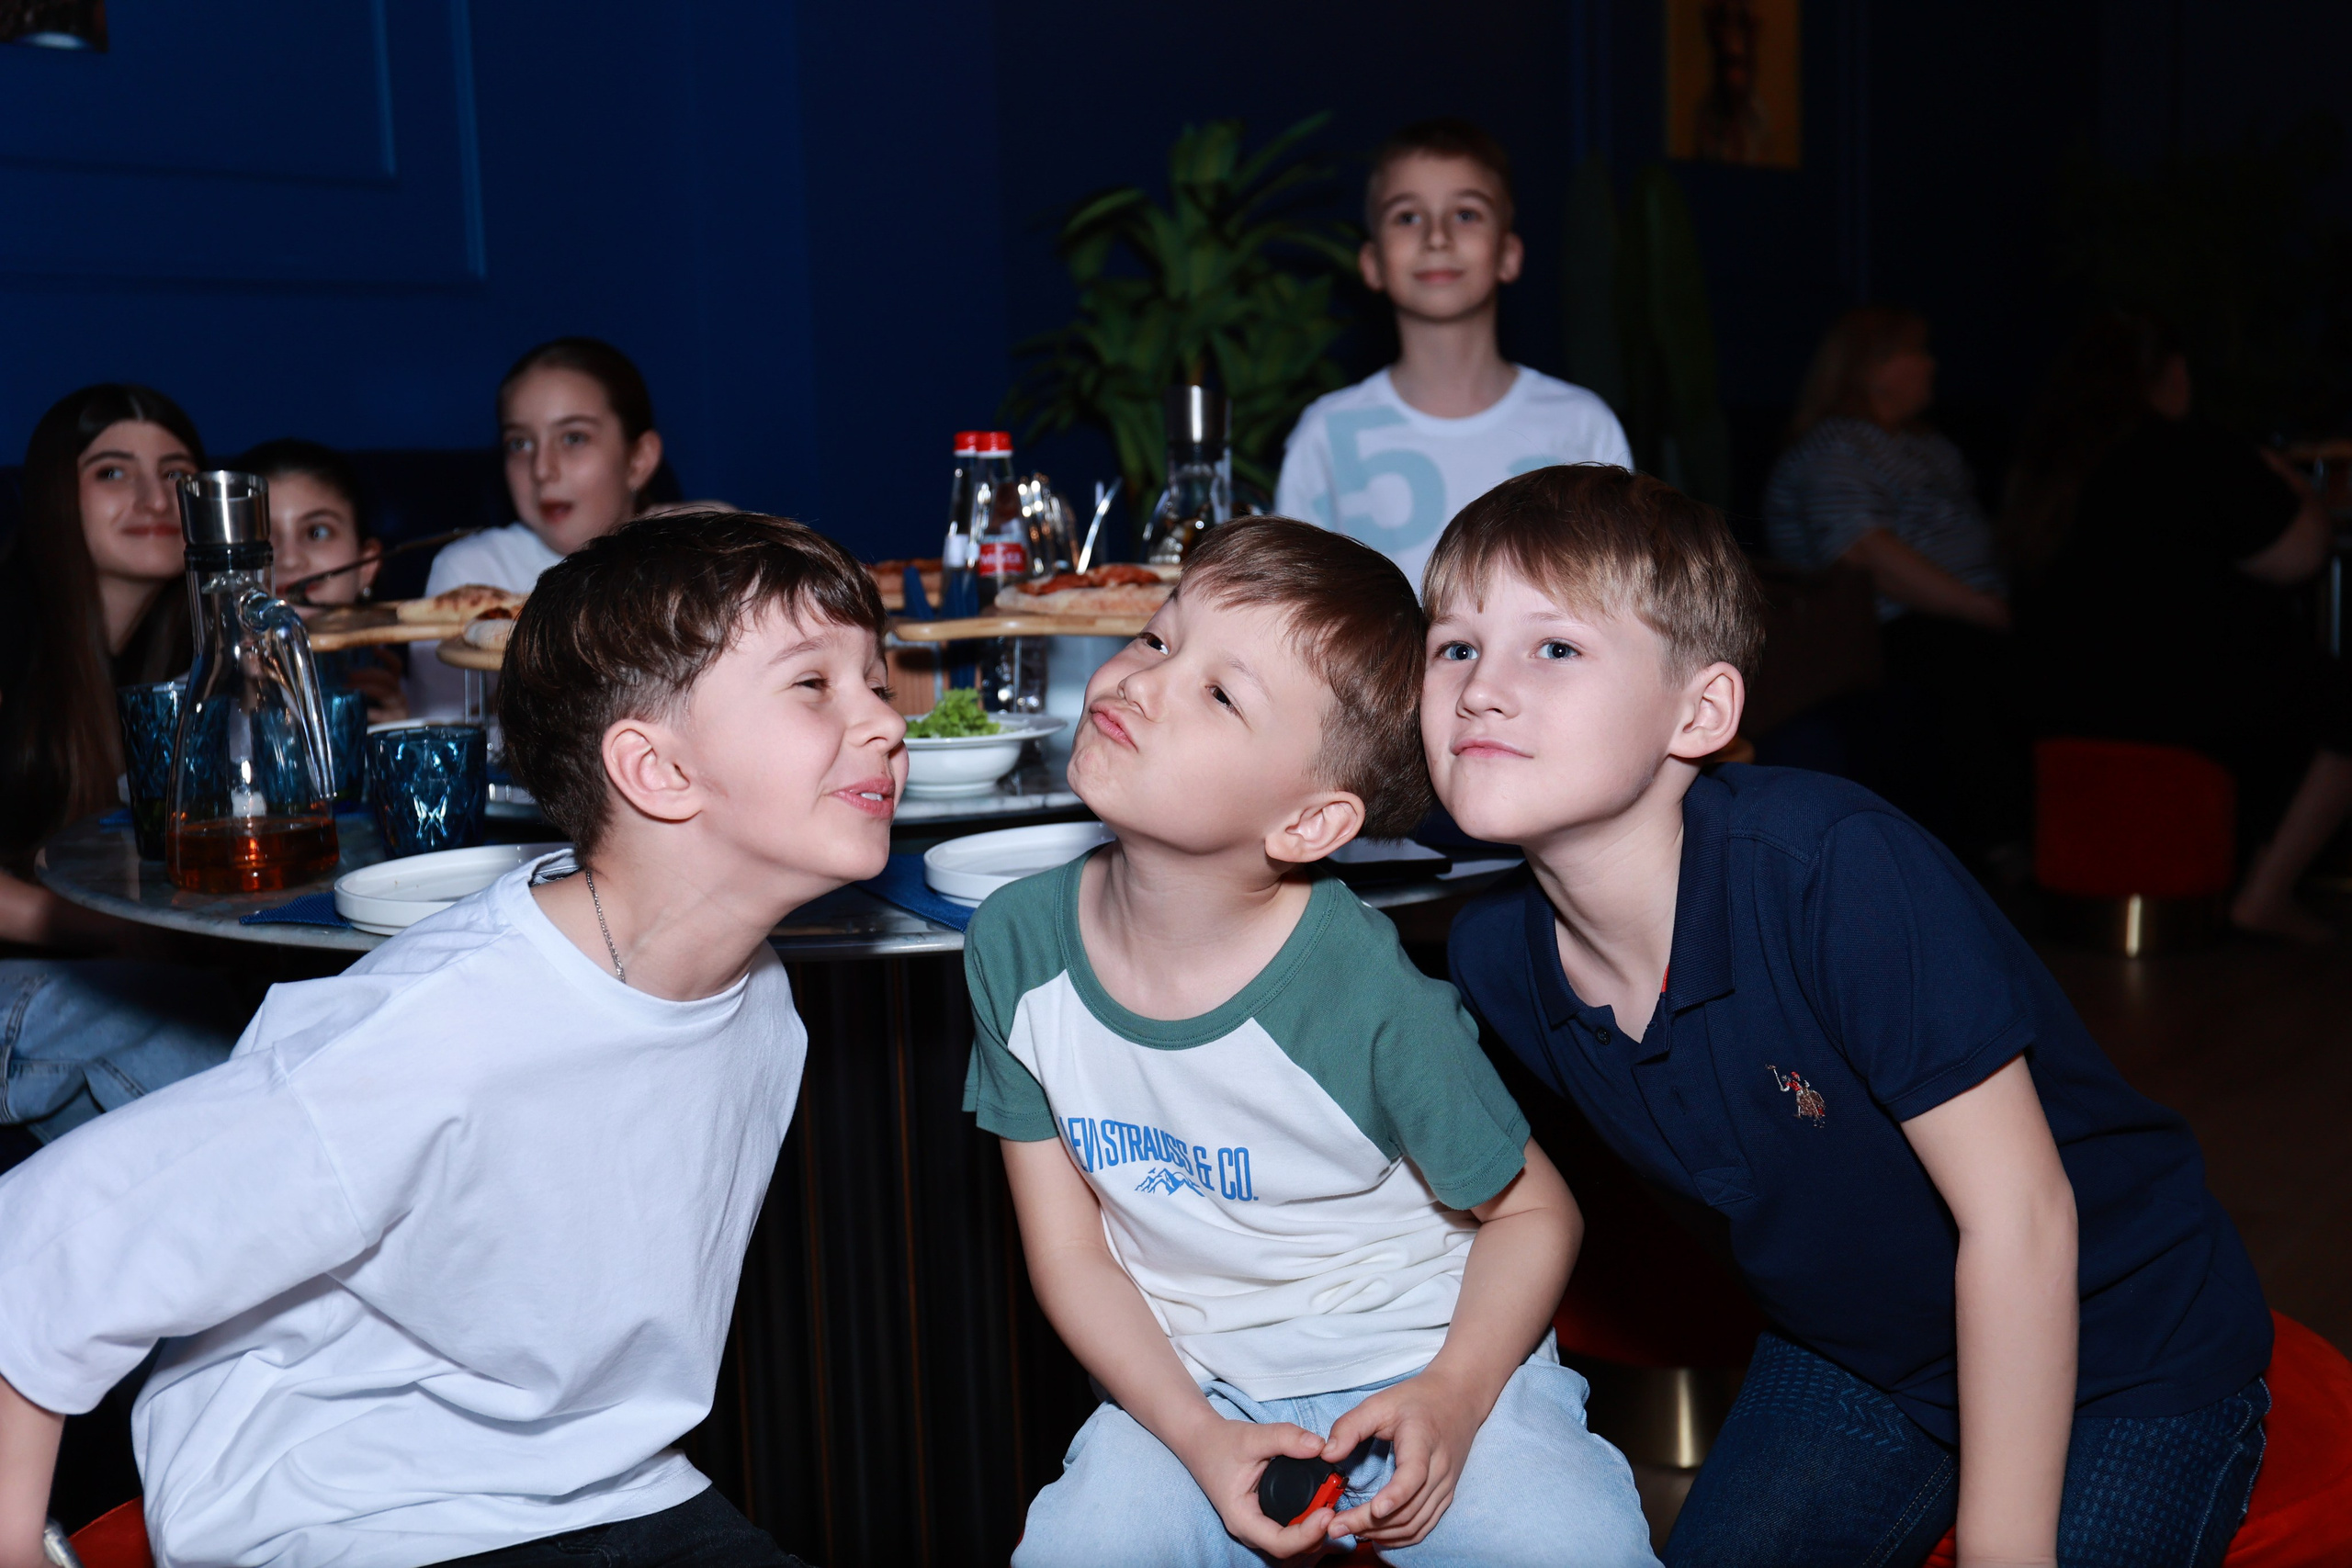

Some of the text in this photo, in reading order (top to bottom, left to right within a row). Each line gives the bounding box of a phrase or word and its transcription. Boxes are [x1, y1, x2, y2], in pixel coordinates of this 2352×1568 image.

[1101, 1120, 1193, 1176] STRAUSS
[1193, 1145, 1215, 1191] &
[1217, 1147, 1259, 1201] CO.
